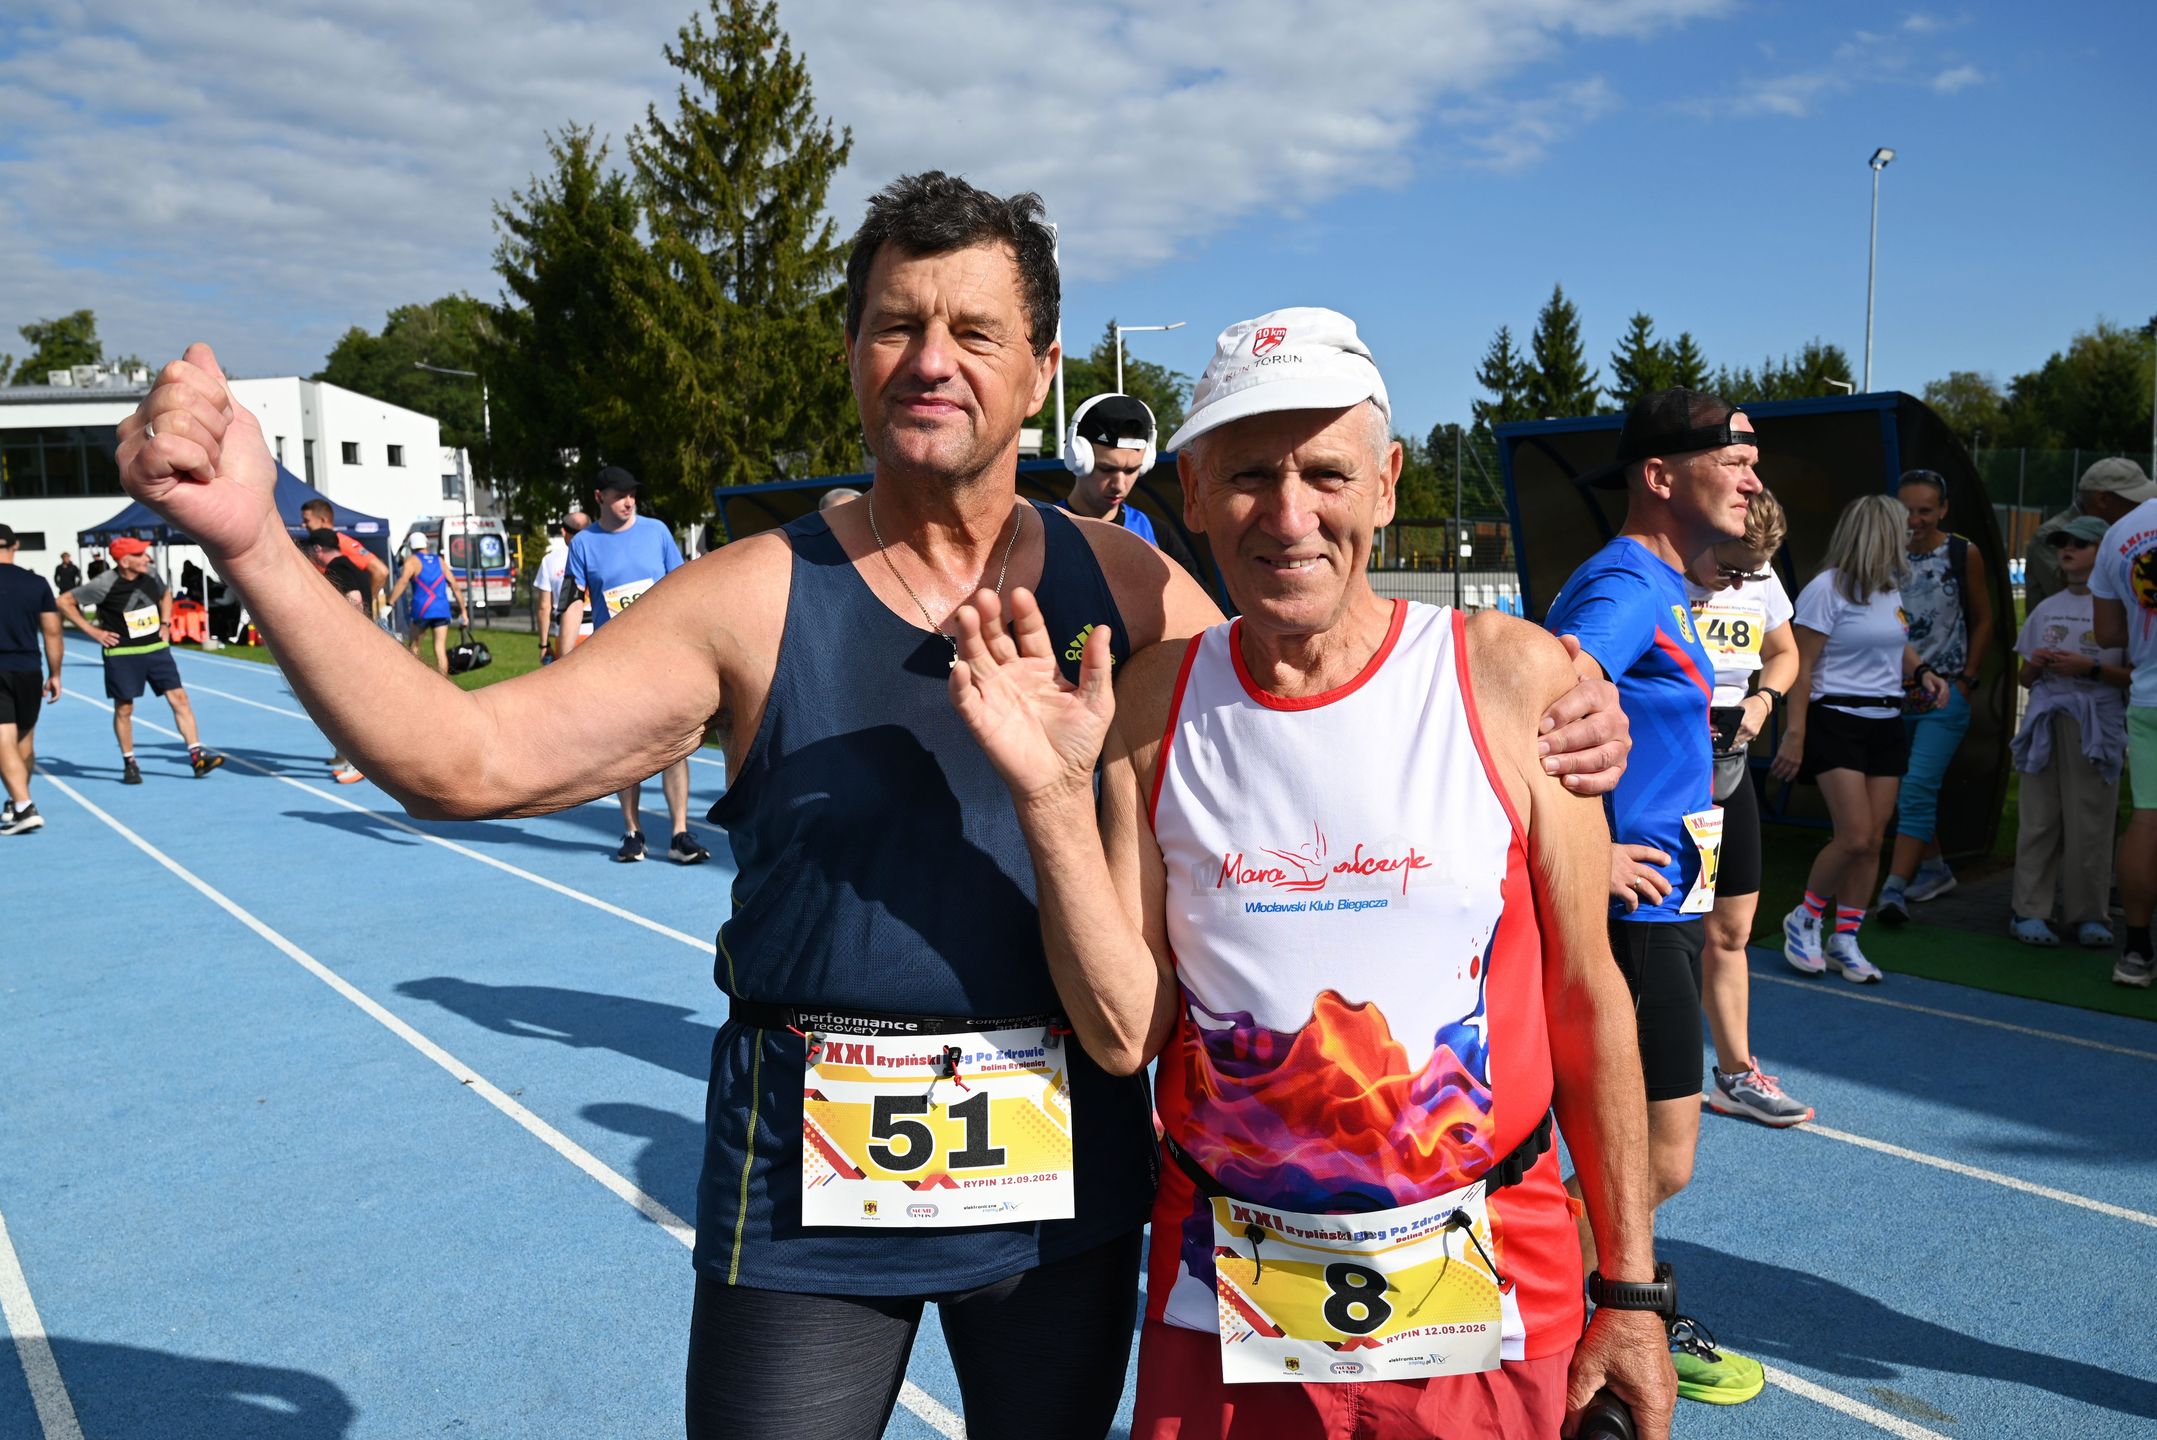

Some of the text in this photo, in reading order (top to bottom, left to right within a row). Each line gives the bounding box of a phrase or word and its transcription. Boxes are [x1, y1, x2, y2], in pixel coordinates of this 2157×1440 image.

[1257, 328, 1286, 337] 10 km
[137, 616, 152, 626] 41
[1706, 619, 1750, 647] 48
[1245, 898, 1389, 913] Włocławski Klub Biegacza
[800, 1012, 919, 1031] performance
[814, 1022, 879, 1037] recovery
[825, 1041, 875, 1066] XXI
[877, 1053, 940, 1068] Rypiński
[976, 1052, 993, 1062] Po
[996, 1046, 1045, 1060] Zdrowie
[868, 1091, 1006, 1171] 51
[963, 1173, 1058, 1188] RYPIN 12.09.2026
[1231, 1204, 1285, 1231] XXI
[1390, 1226, 1408, 1236] Po
[1324, 1262, 1392, 1335] 8
[1386, 1323, 1487, 1344] RYPIN 12.09.2026
